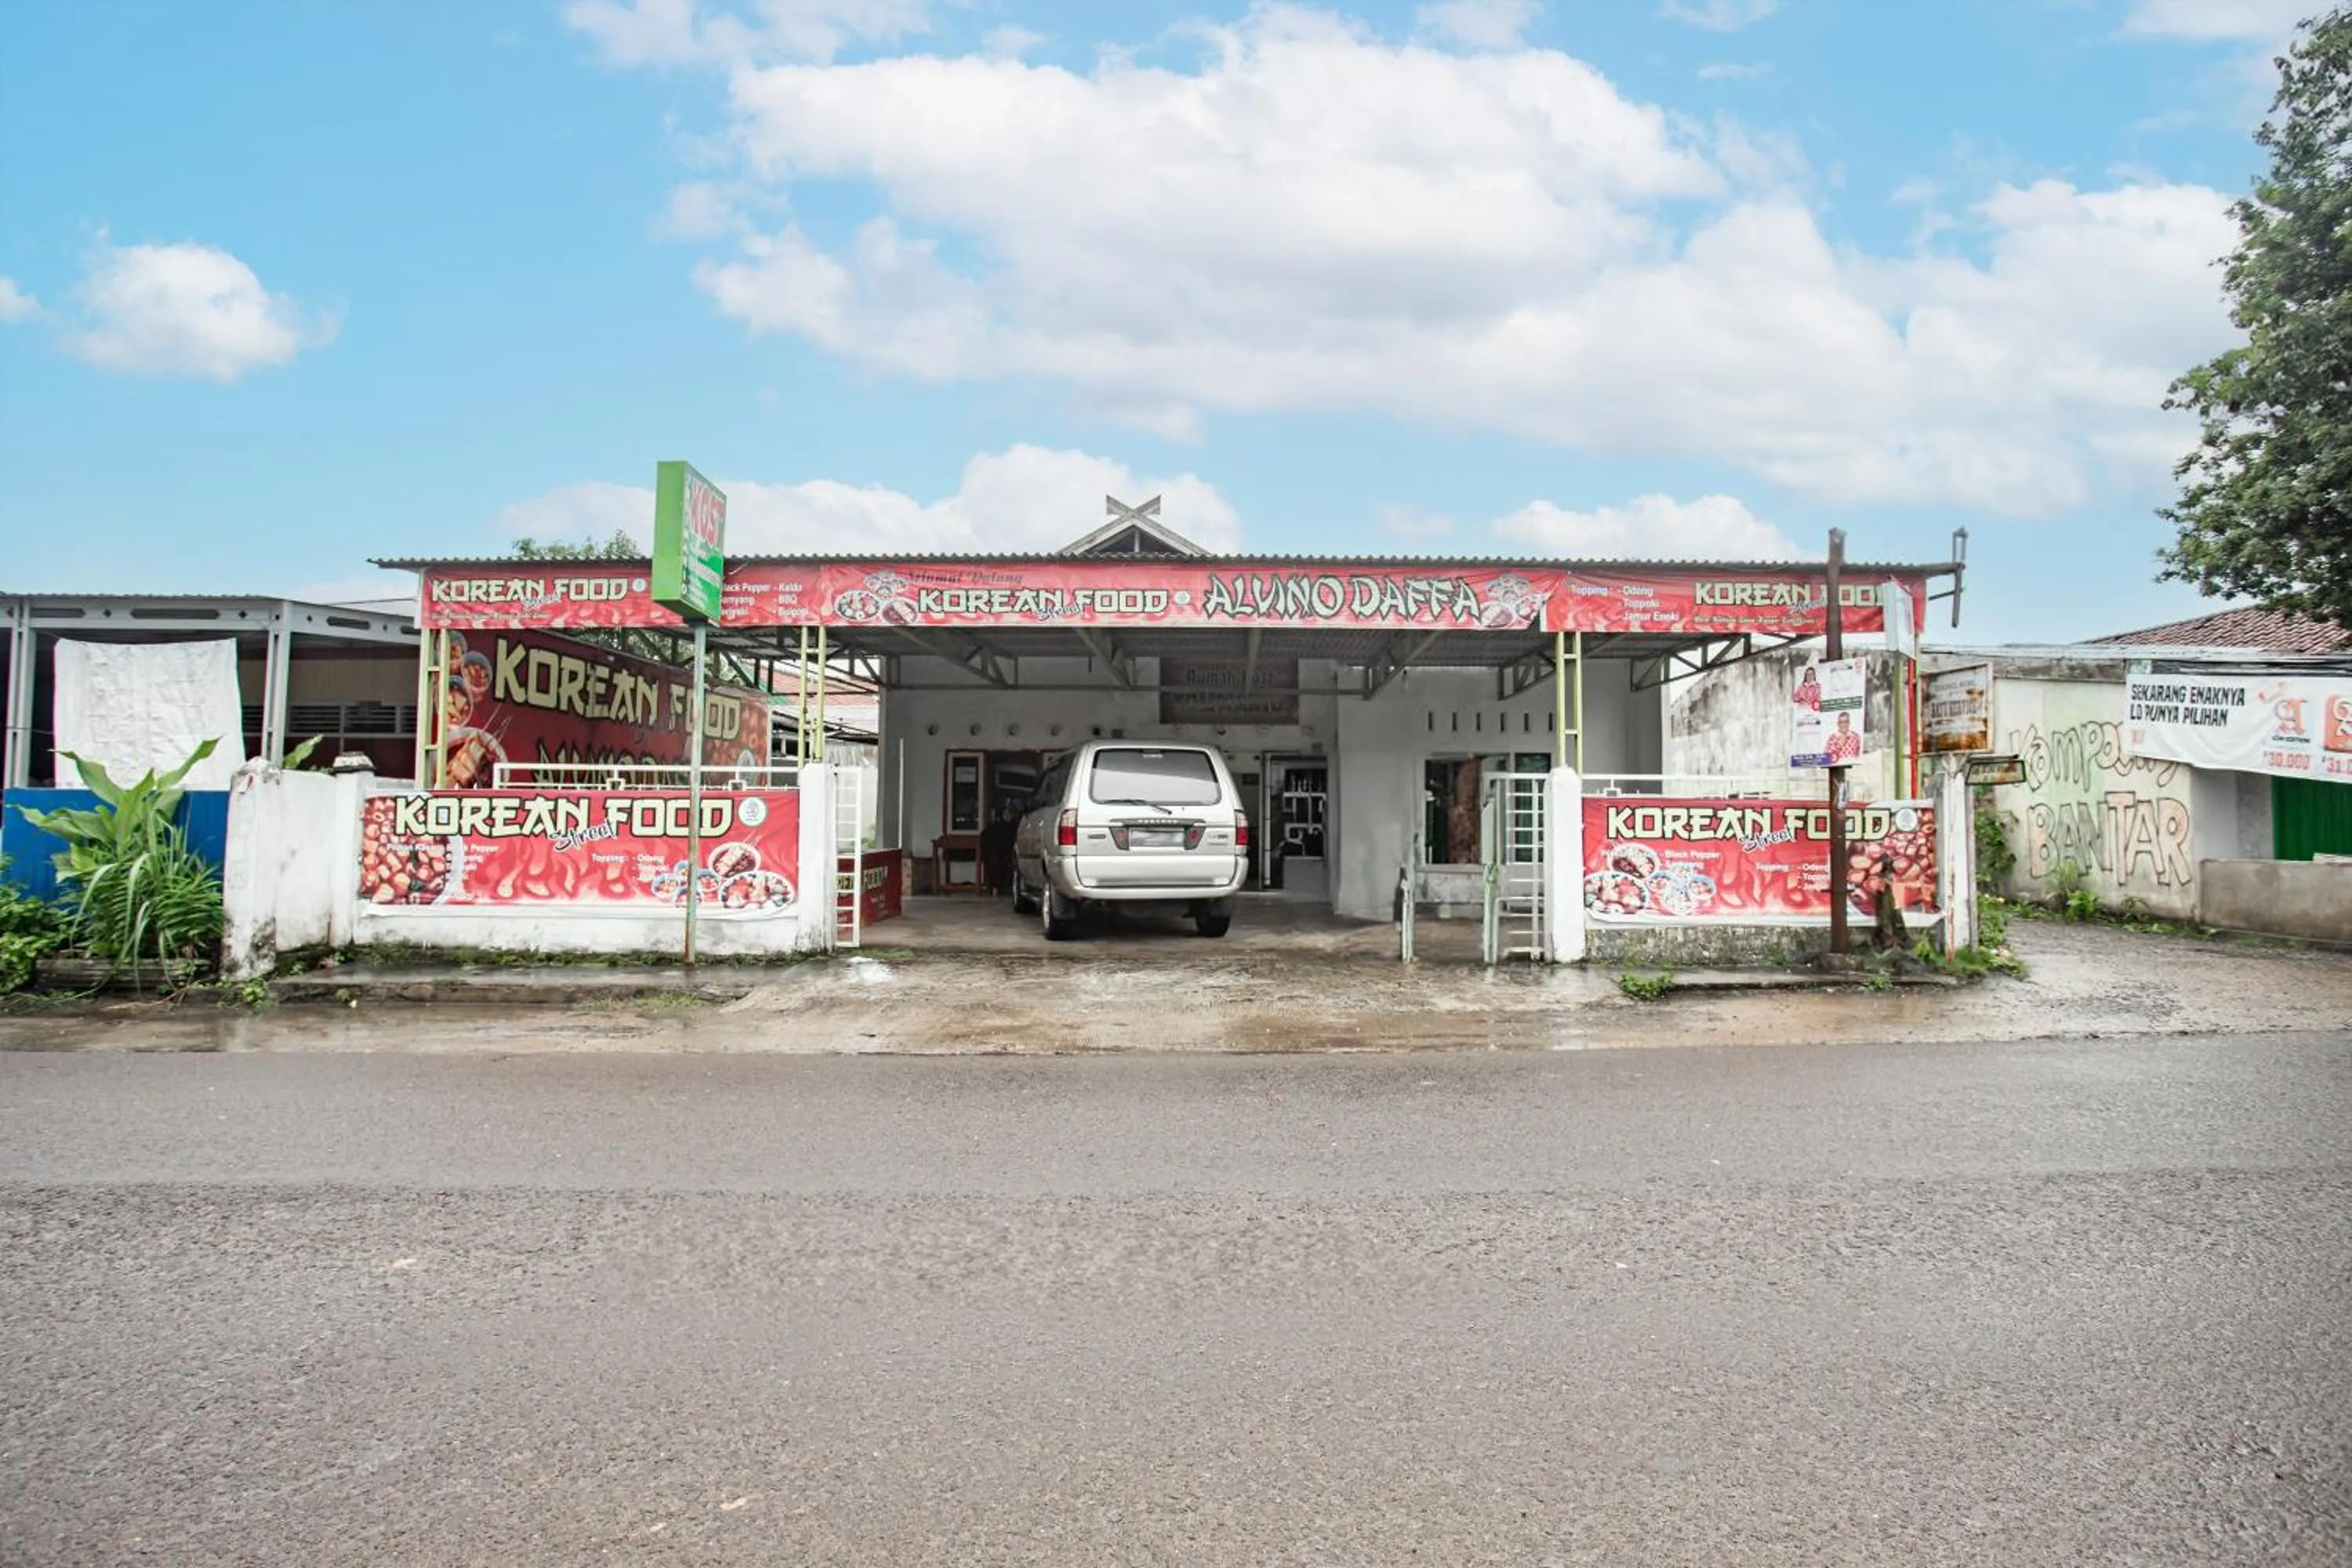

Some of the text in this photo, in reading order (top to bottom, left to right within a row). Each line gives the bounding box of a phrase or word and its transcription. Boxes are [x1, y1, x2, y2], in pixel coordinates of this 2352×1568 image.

[431, 578, 628, 602] KOREAN FOOD
[724, 583, 739, 592] lack
[918, 587, 1169, 614] KOREAN FOOD
[1203, 574, 1482, 622] ALVINO DAFFA
[1694, 582, 1813, 607] KOREAN
[495, 637, 659, 727] KOREAN
[2131, 684, 2245, 706] SEKARANG ENAKNYA
[2144, 704, 2180, 723] PUNYA
[2182, 706, 2229, 726] PILIHAN
[394, 793, 734, 837] KOREAN FOOD
[1606, 806, 1892, 841] KOREAN FOOD
[549, 819, 618, 851] Street
[1740, 827, 1796, 852] Street
[2027, 790, 2193, 887] BANTAR
